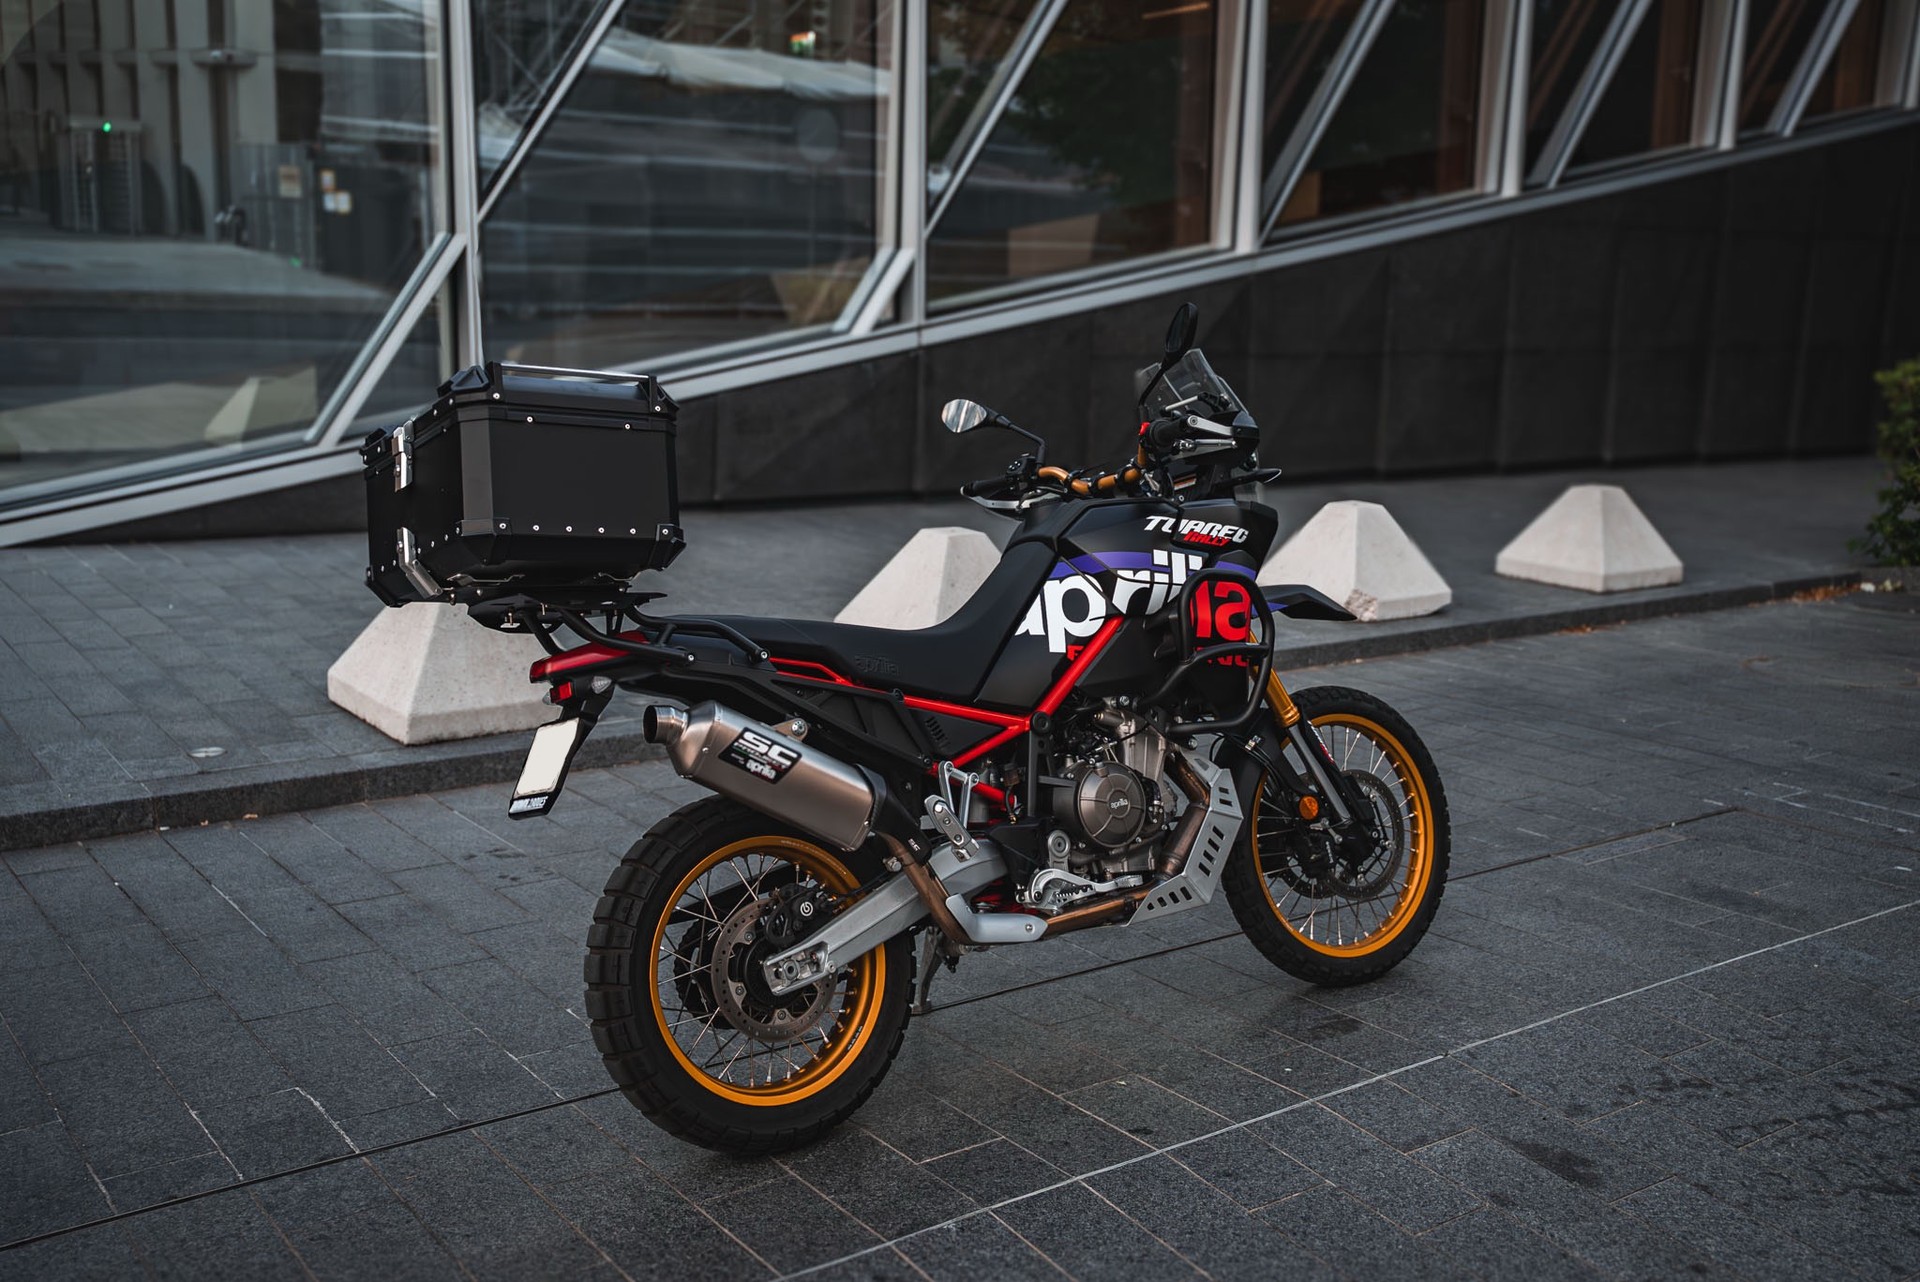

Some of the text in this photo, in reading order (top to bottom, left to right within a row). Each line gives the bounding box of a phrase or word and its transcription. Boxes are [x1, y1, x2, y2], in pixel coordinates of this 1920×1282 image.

[1183, 531, 1231, 547] RALLY
[738, 731, 798, 765] SC
[1110, 798, 1129, 809] aprilia
